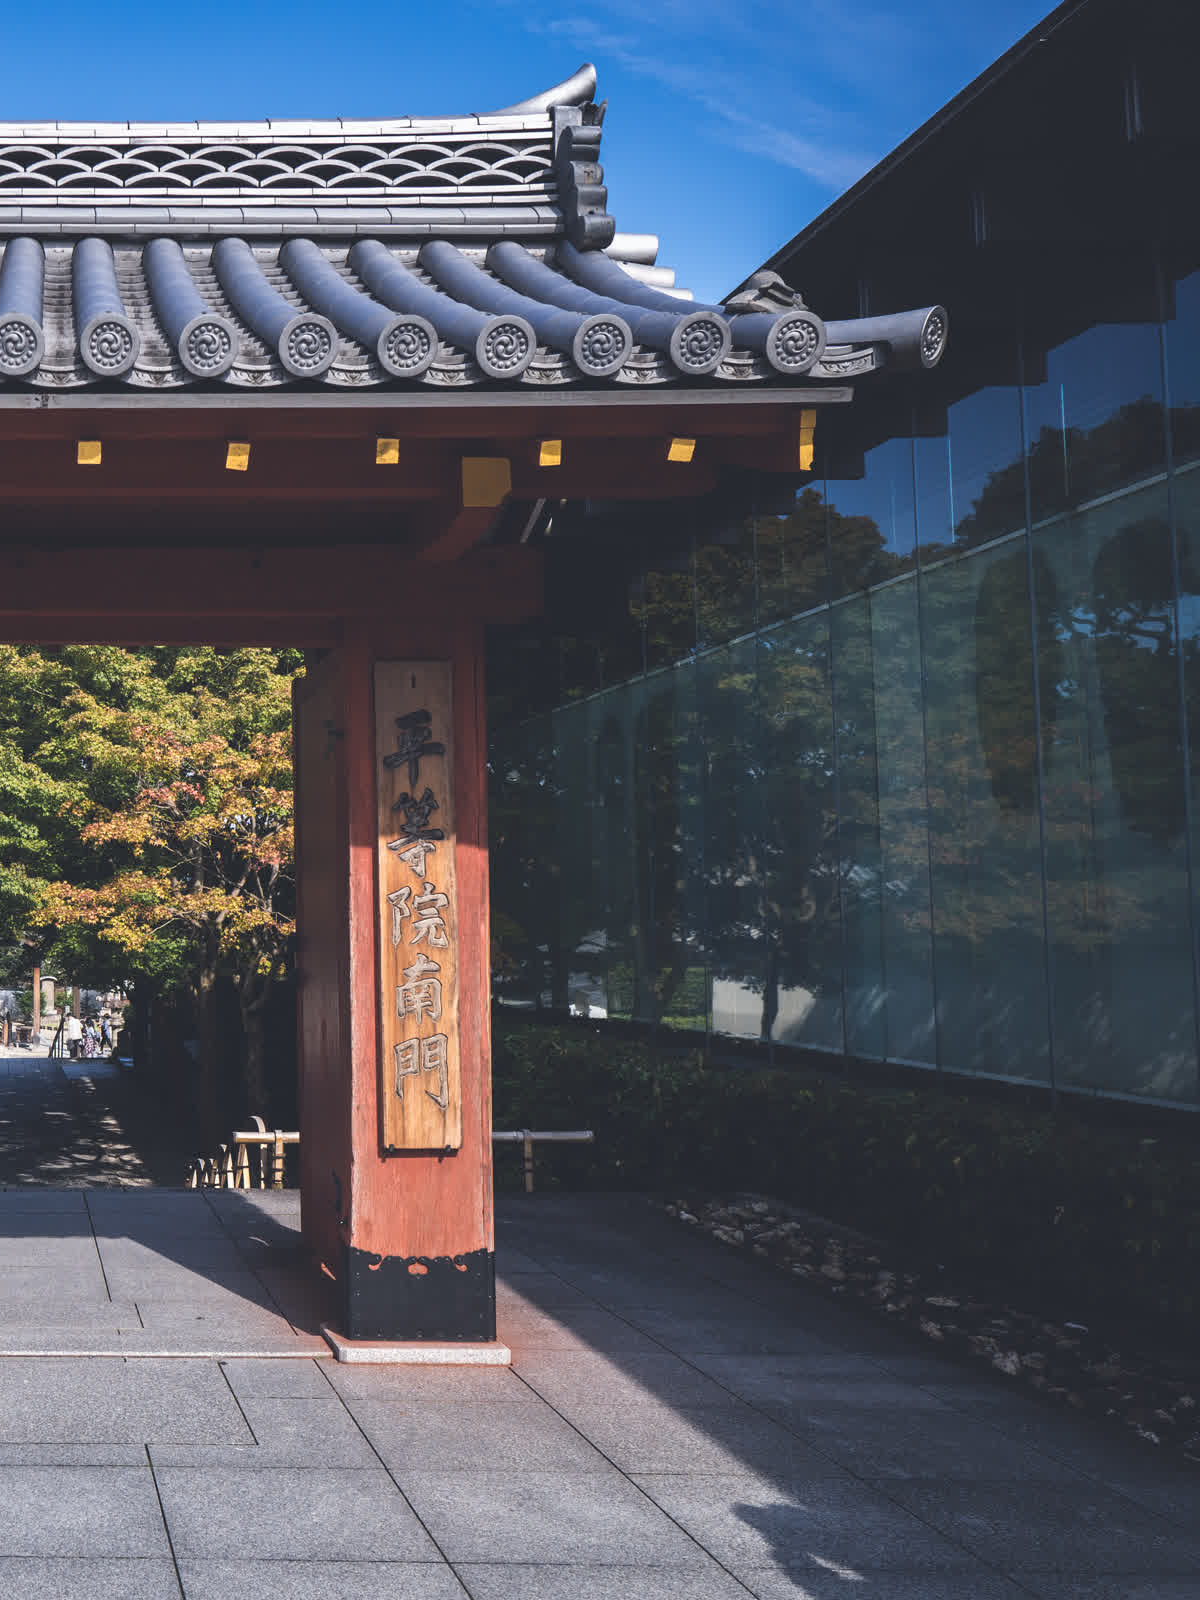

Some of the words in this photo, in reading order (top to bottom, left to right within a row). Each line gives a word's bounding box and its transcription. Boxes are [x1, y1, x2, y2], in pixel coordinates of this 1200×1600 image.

[383, 708, 450, 1110] 平等院南門
